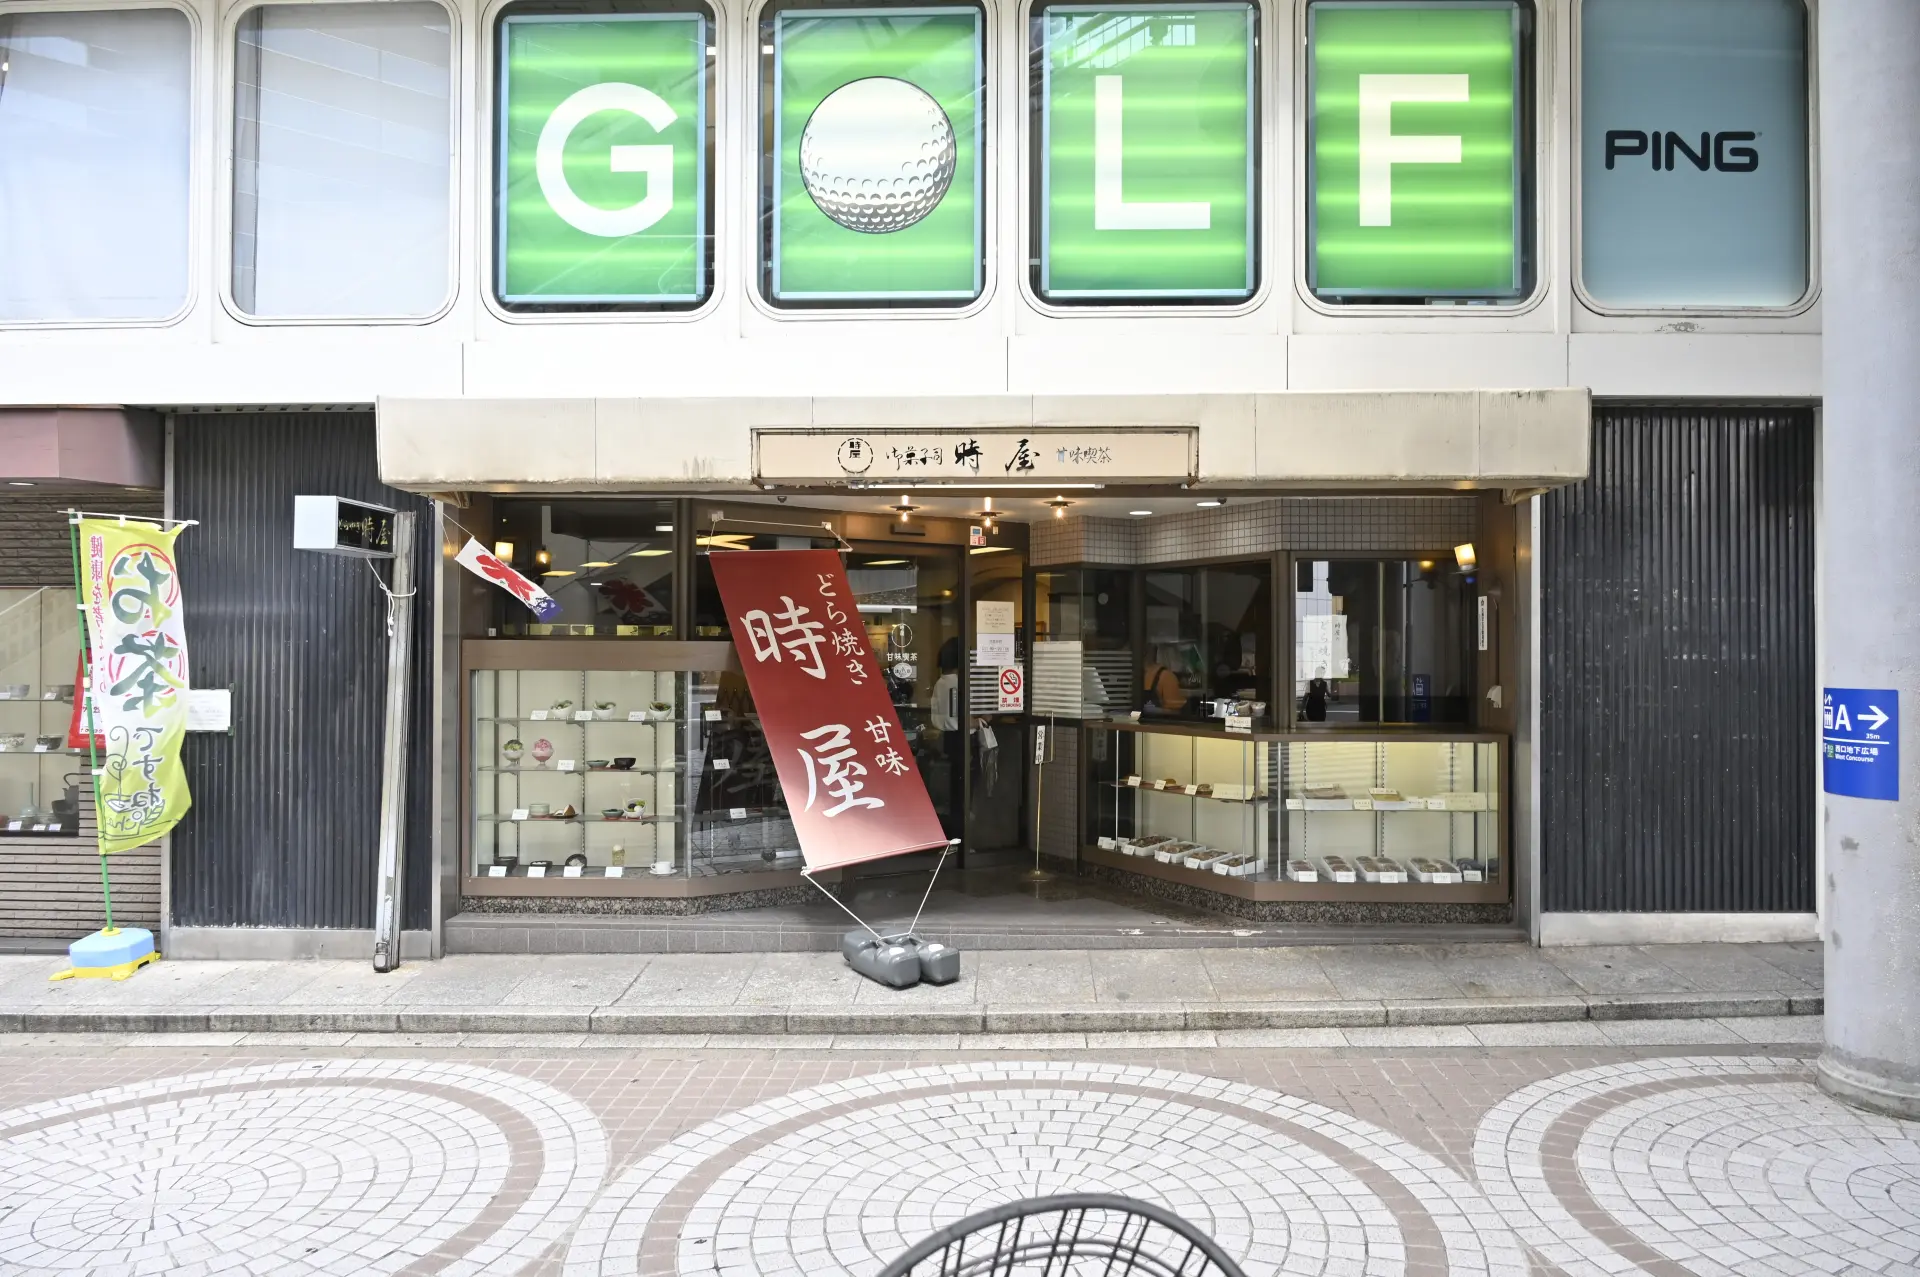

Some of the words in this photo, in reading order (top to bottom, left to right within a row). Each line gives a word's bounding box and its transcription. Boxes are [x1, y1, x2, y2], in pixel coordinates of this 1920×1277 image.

[1605, 129, 1760, 173] PING
[954, 437, 1041, 473] 時屋
[816, 573, 869, 686] どら焼き
[863, 715, 911, 777] 甘味
[740, 595, 885, 818] 時屋
[1835, 704, 1852, 731] A
